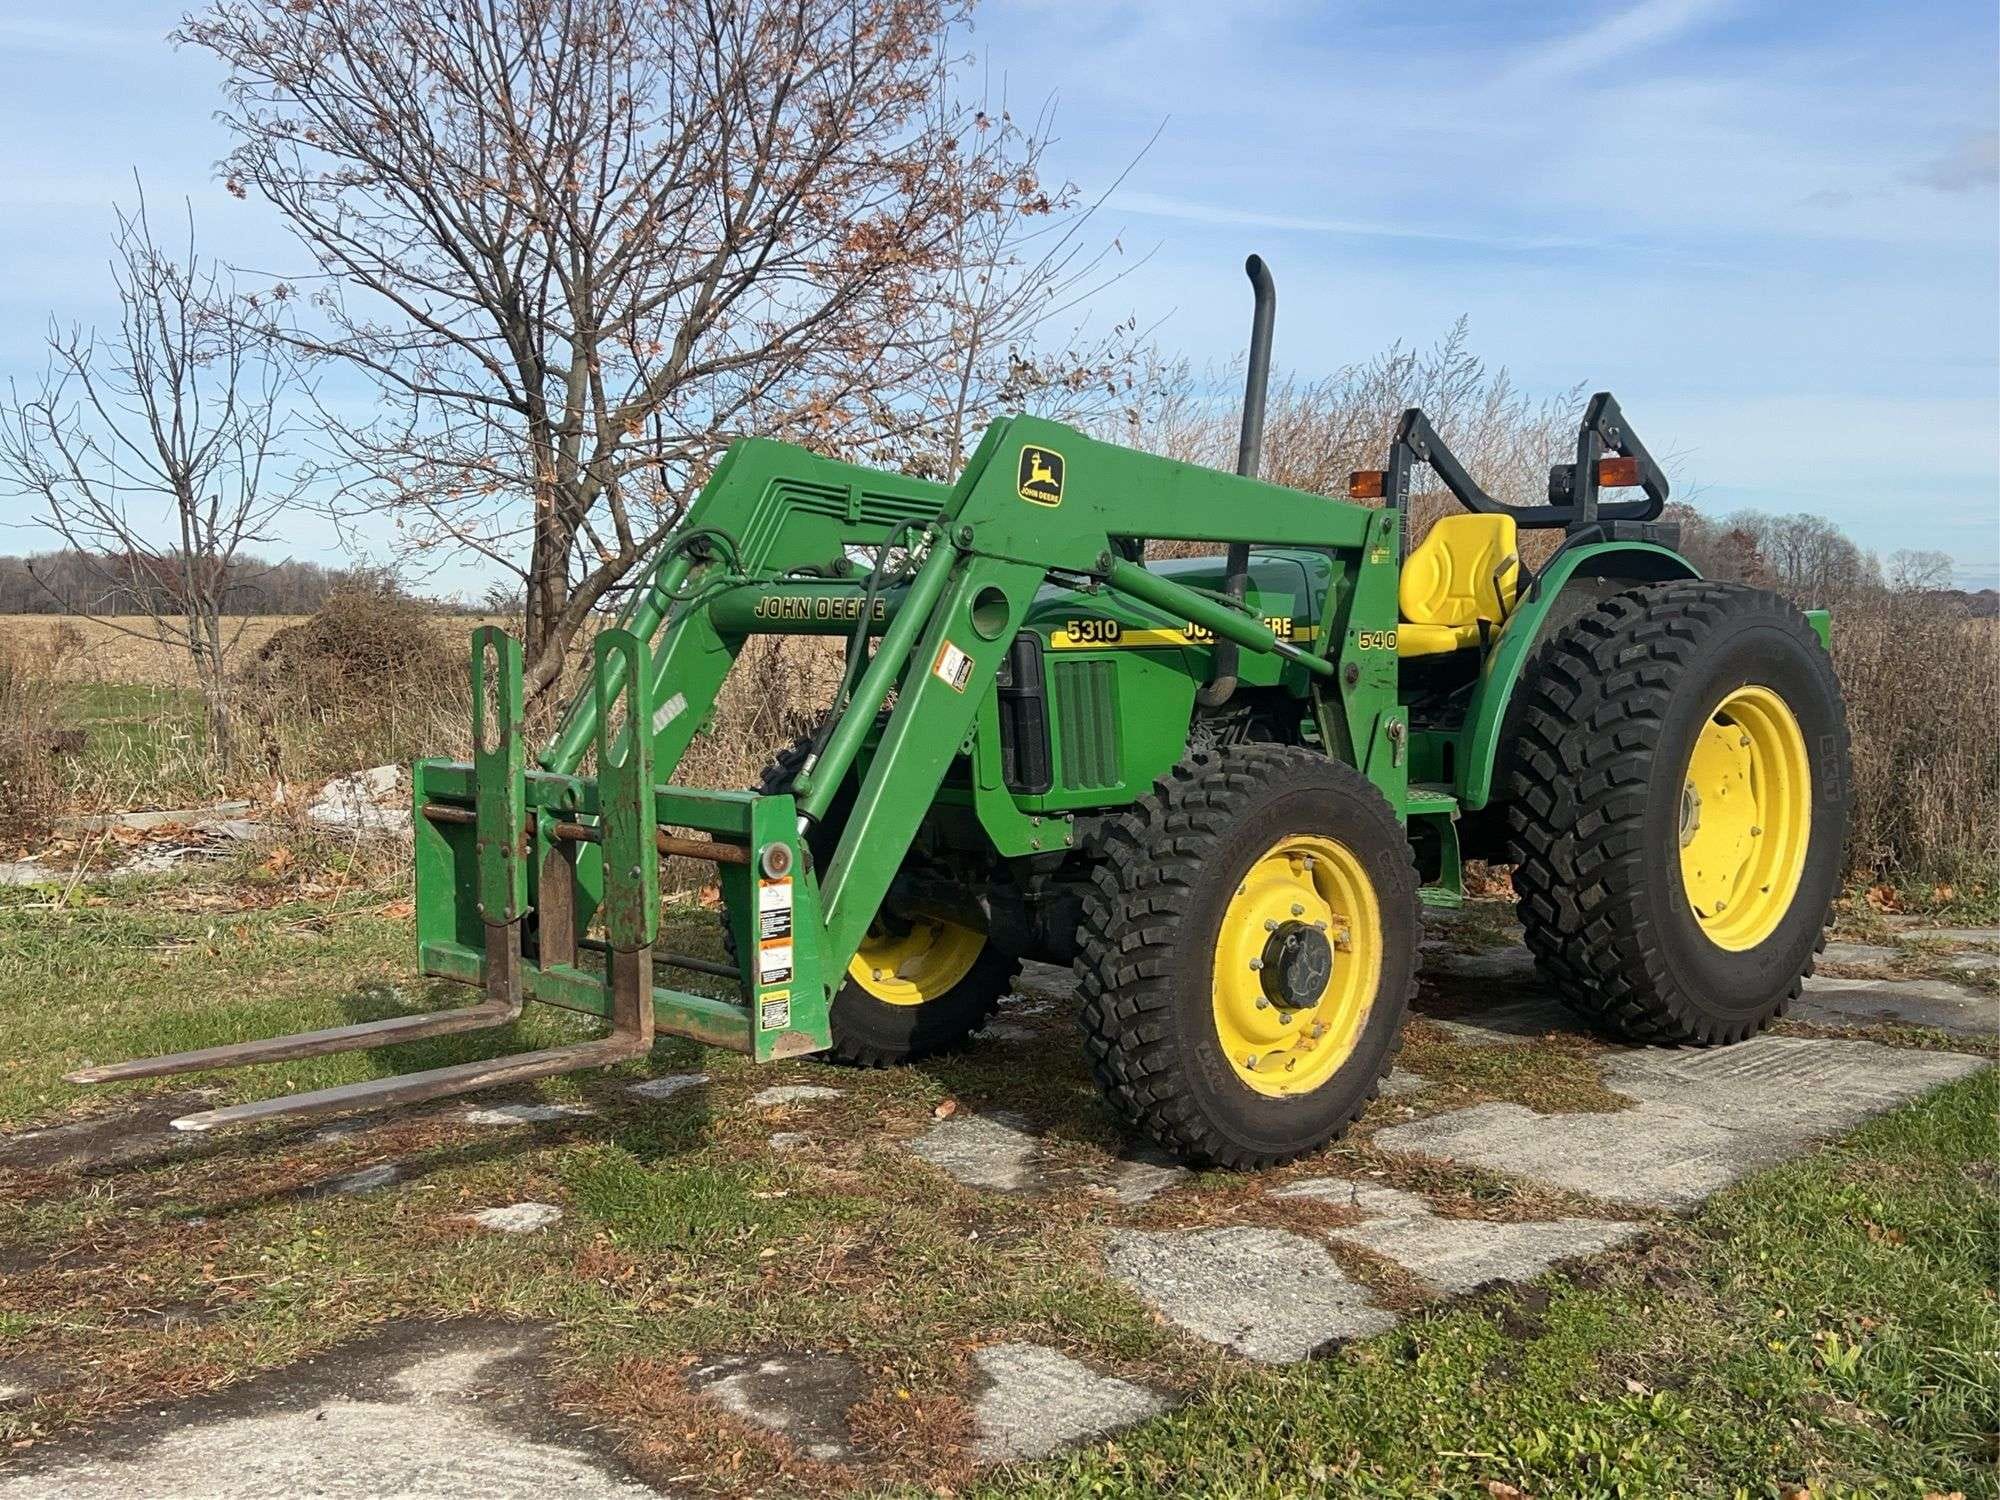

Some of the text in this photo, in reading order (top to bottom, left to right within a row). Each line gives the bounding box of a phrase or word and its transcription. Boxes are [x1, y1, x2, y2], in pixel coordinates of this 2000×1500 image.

[1021, 487, 1059, 502] JOHN DEERE
[754, 596, 812, 619] JOHN
[1067, 619, 1119, 641] 5310
[1359, 630, 1398, 651] 540
